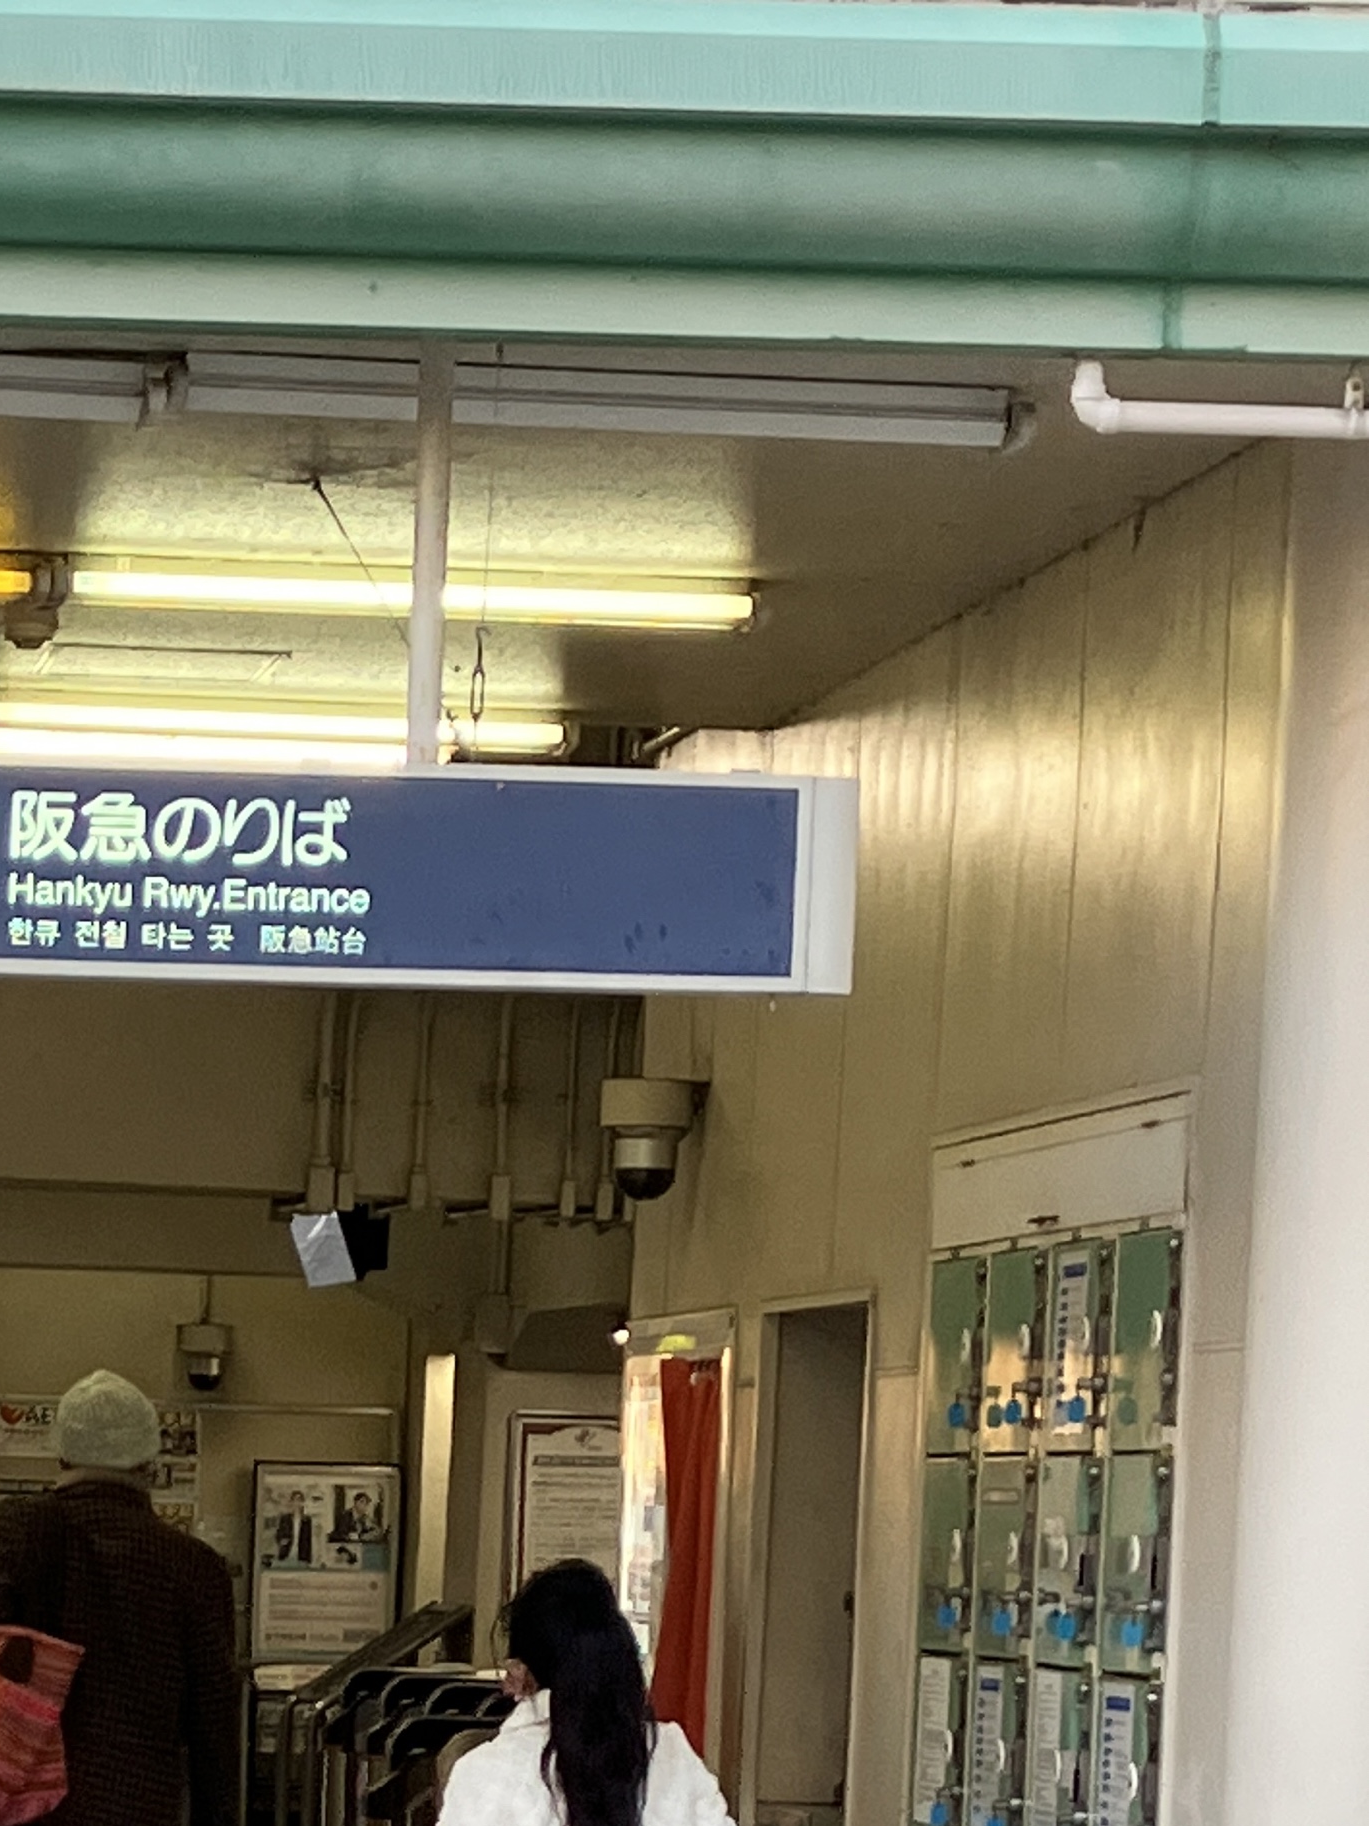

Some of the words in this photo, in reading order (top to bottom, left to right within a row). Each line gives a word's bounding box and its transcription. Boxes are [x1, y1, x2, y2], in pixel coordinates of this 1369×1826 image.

[9, 788, 352, 867] 阪急のりば
[7, 872, 133, 915] Hankyu
[8, 916, 61, 947] 한큐
[141, 921, 195, 951] 타는
